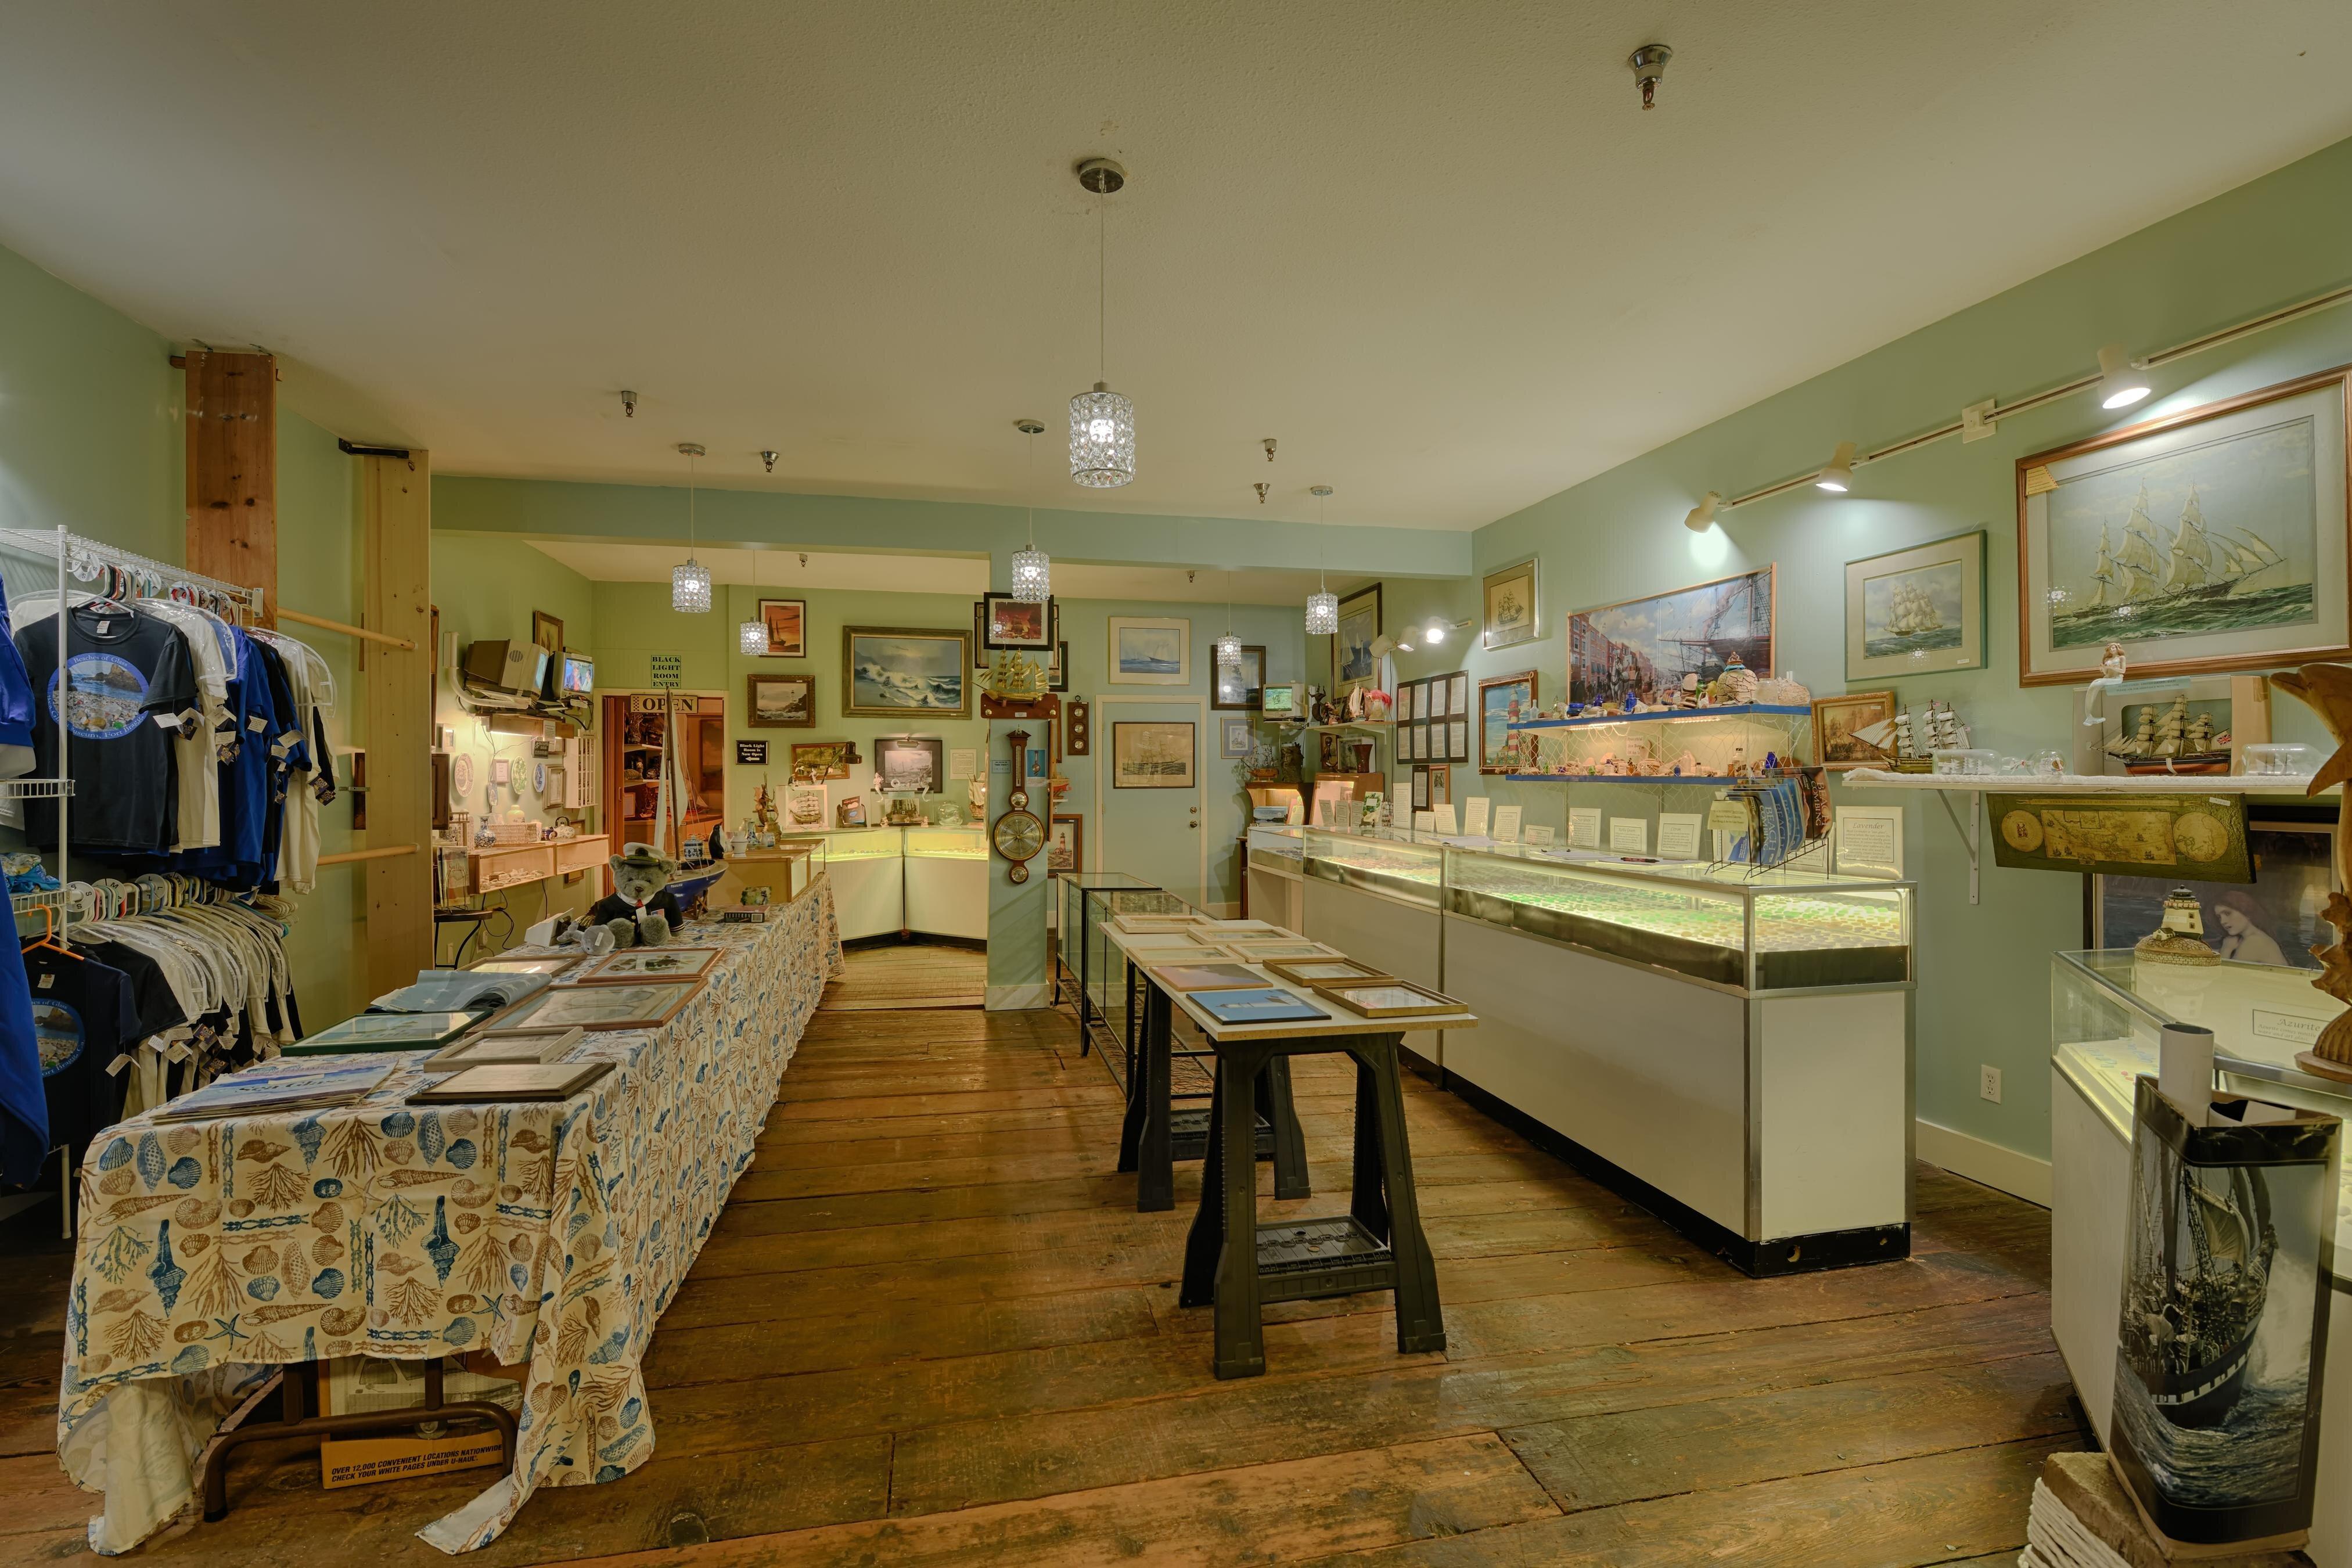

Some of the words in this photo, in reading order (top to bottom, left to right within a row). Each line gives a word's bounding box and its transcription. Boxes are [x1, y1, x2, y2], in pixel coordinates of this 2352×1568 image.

[74, 654, 99, 663] Beaches
[111, 657, 128, 667] Glass
[642, 698, 694, 711] OPEN
[123, 715, 145, 732] Bragg,
[1811, 781, 1822, 826] COMBING
[1818, 782, 1828, 826] BEACH
[1760, 805, 1770, 851] COMBING
[1765, 807, 1776, 851] BEACH
[1776, 803, 1786, 851] BEACH
[52, 1001, 68, 1010] Glass
[2277, 1018, 2321, 1031] Azurite
[332, 1466, 350, 1475] OVER
[353, 1462, 376, 1472] 12,000
[377, 1455, 421, 1468] CONVENIENT
[423, 1451, 459, 1461] LOCATIONS
[461, 1444, 502, 1456] NATIONWIDE
[332, 1473, 355, 1482] CHECK
[358, 1469, 376, 1479] YOUR
[379, 1466, 401, 1475] WHITE
[402, 1462, 425, 1472] PAGES
[427, 1459, 449, 1468] UNDER
